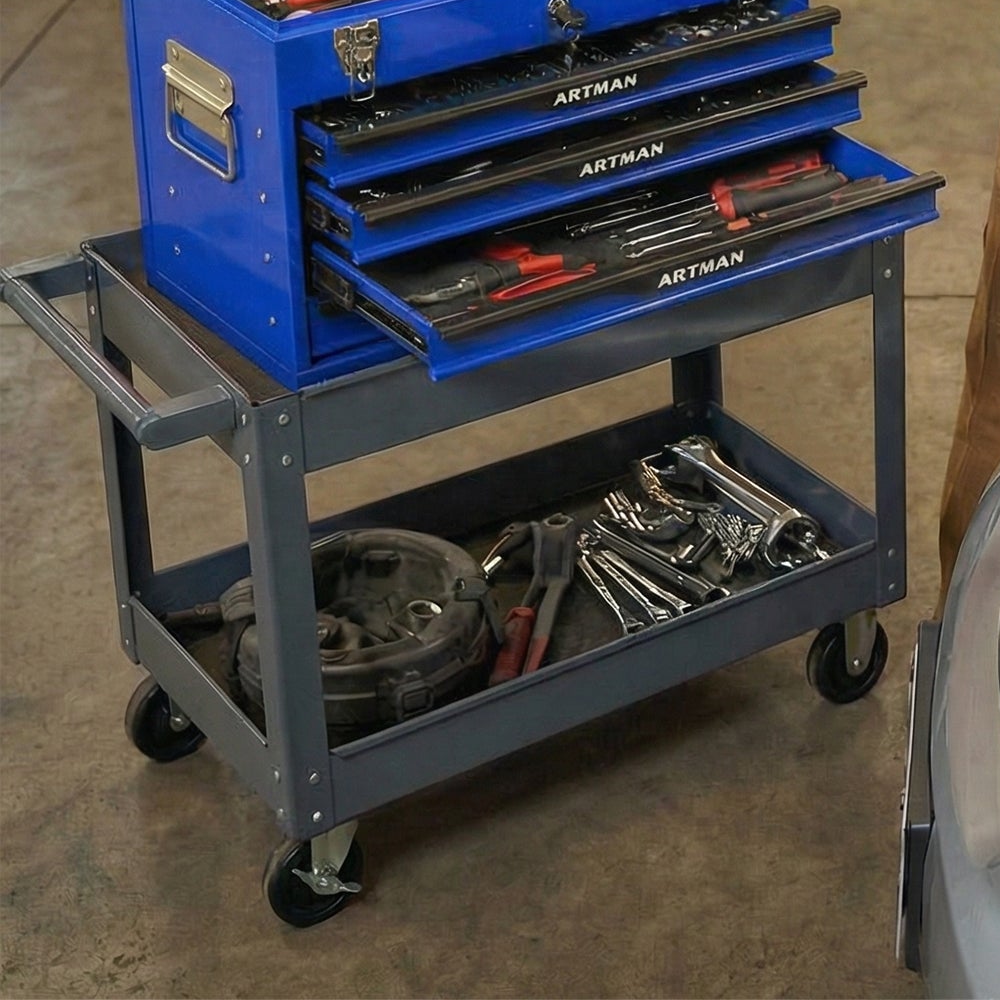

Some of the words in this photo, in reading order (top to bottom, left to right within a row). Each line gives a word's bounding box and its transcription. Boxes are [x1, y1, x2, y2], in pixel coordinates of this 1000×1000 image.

[553, 73, 637, 107] ARTMAN
[579, 141, 664, 178] ARTMAN
[657, 249, 744, 289] ARTMAN
